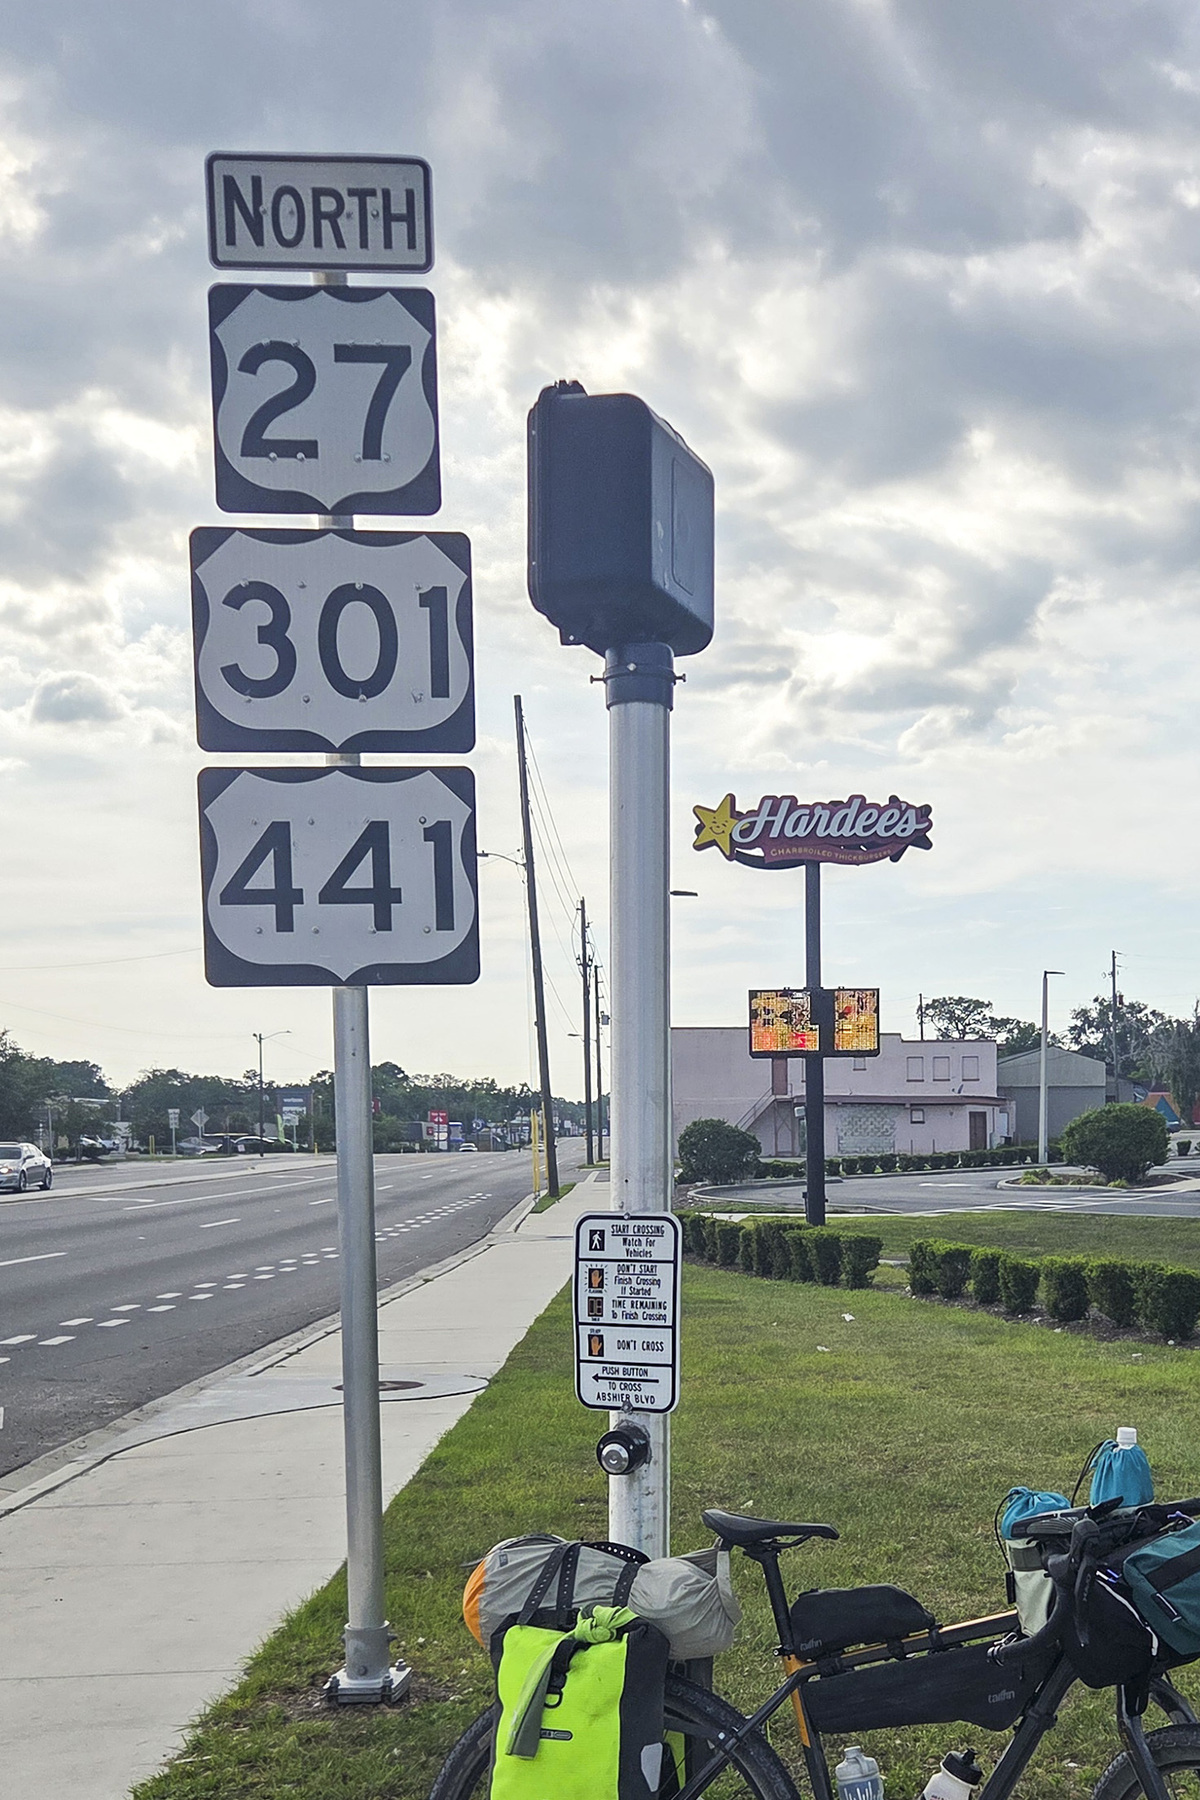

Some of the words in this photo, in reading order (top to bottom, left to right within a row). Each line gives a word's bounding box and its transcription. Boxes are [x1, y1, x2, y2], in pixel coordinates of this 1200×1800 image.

[222, 174, 417, 250] NORTH
[237, 340, 412, 461] 27
[219, 580, 450, 699] 301
[731, 798, 930, 843] Hardee's
[770, 845, 833, 857] CHARBROILED
[219, 819, 455, 933] 441
[611, 1224, 629, 1234] START
[633, 1225, 665, 1235] CROSSING
[622, 1238, 642, 1247] Watch
[645, 1238, 656, 1247] For
[625, 1248, 653, 1258] Vehicles
[617, 1264, 636, 1273] DON'T
[639, 1264, 658, 1274] START
[614, 1276, 633, 1285] Finish
[636, 1276, 661, 1289] Crossing
[629, 1286, 651, 1296] Started
[611, 1299, 626, 1309] TIME
[630, 1300, 667, 1310] REMAINING
[622, 1310, 639, 1320] Finish
[642, 1311, 667, 1323] Crossing
[617, 1339, 637, 1350] DON'T
[642, 1340, 664, 1352] CROSS
[602, 1366, 620, 1376] PUSH
[622, 1367, 649, 1377] BUTTON
[608, 1382, 617, 1391] TO
[619, 1382, 642, 1392] CROSS
[596, 1392, 631, 1403] ABSHIER
[635, 1394, 656, 1405] BLVD
